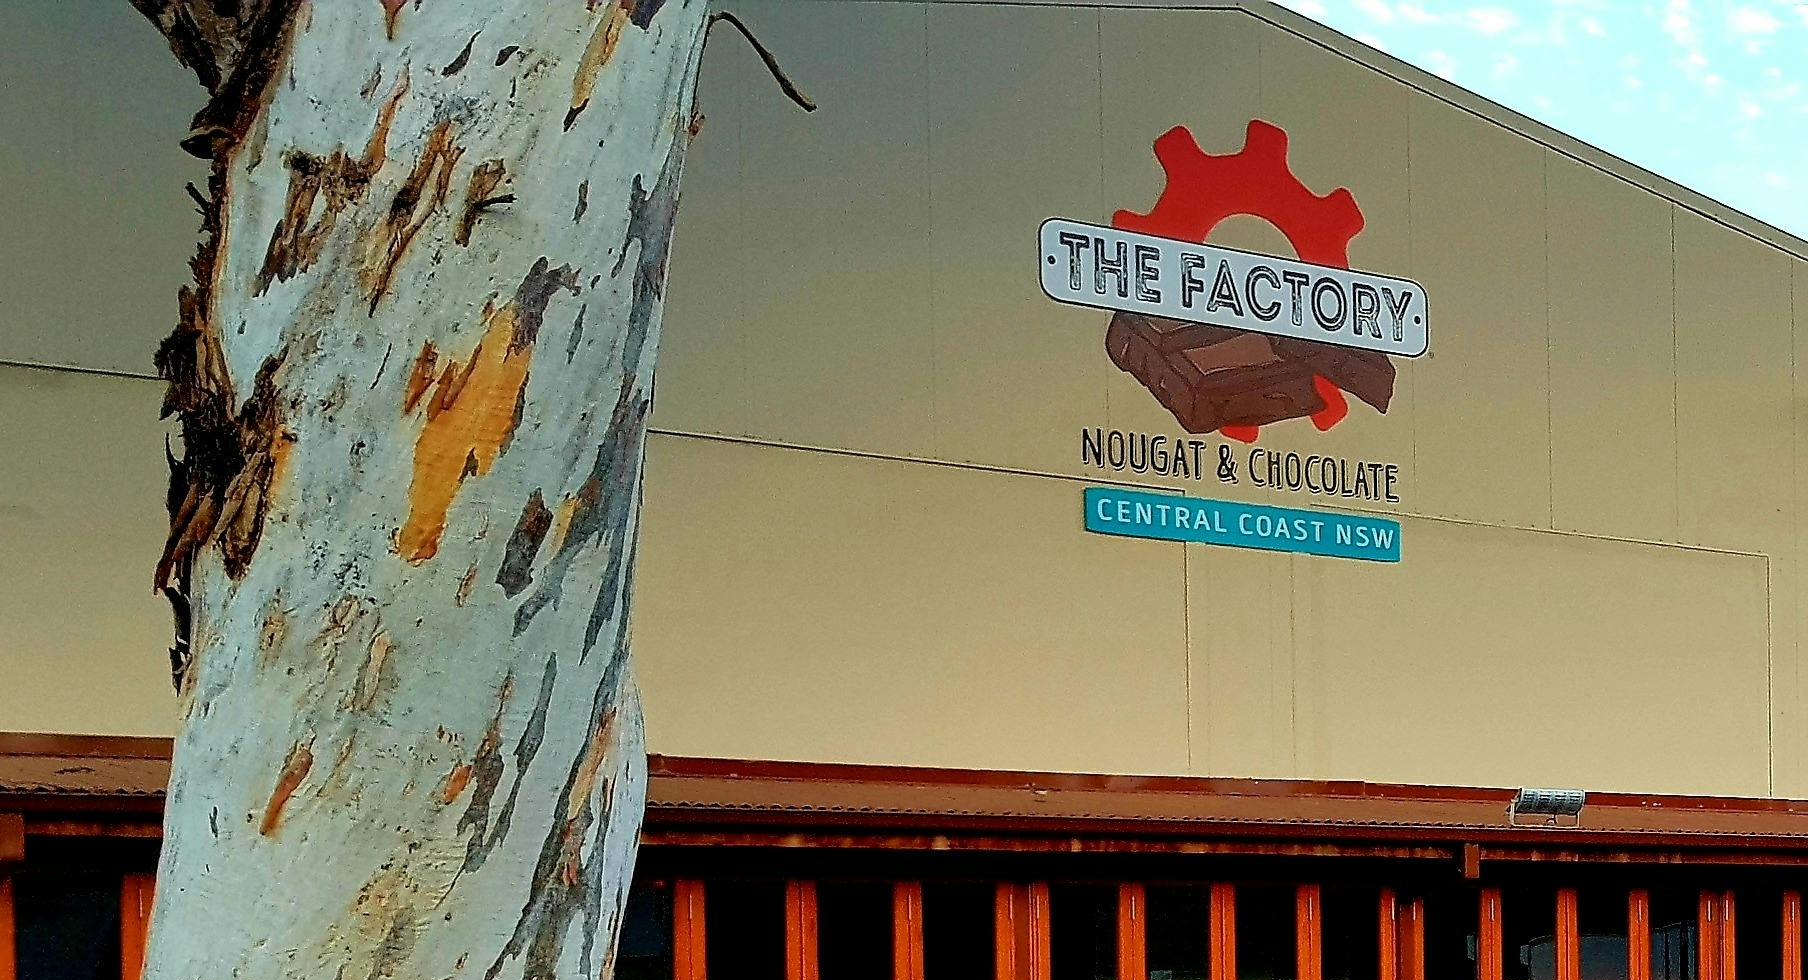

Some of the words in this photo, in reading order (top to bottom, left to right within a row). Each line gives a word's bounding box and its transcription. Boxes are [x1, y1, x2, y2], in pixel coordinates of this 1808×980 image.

[1059, 232, 1162, 303] THE
[1180, 252, 1412, 343] FACTORY
[1081, 428, 1206, 480] NOUGAT
[1217, 443, 1238, 484] &
[1248, 448, 1400, 502] CHOCOLATE
[1097, 498, 1227, 533] CENTRAL
[1238, 513, 1323, 542] COAST
[1336, 524, 1394, 549] NSW
